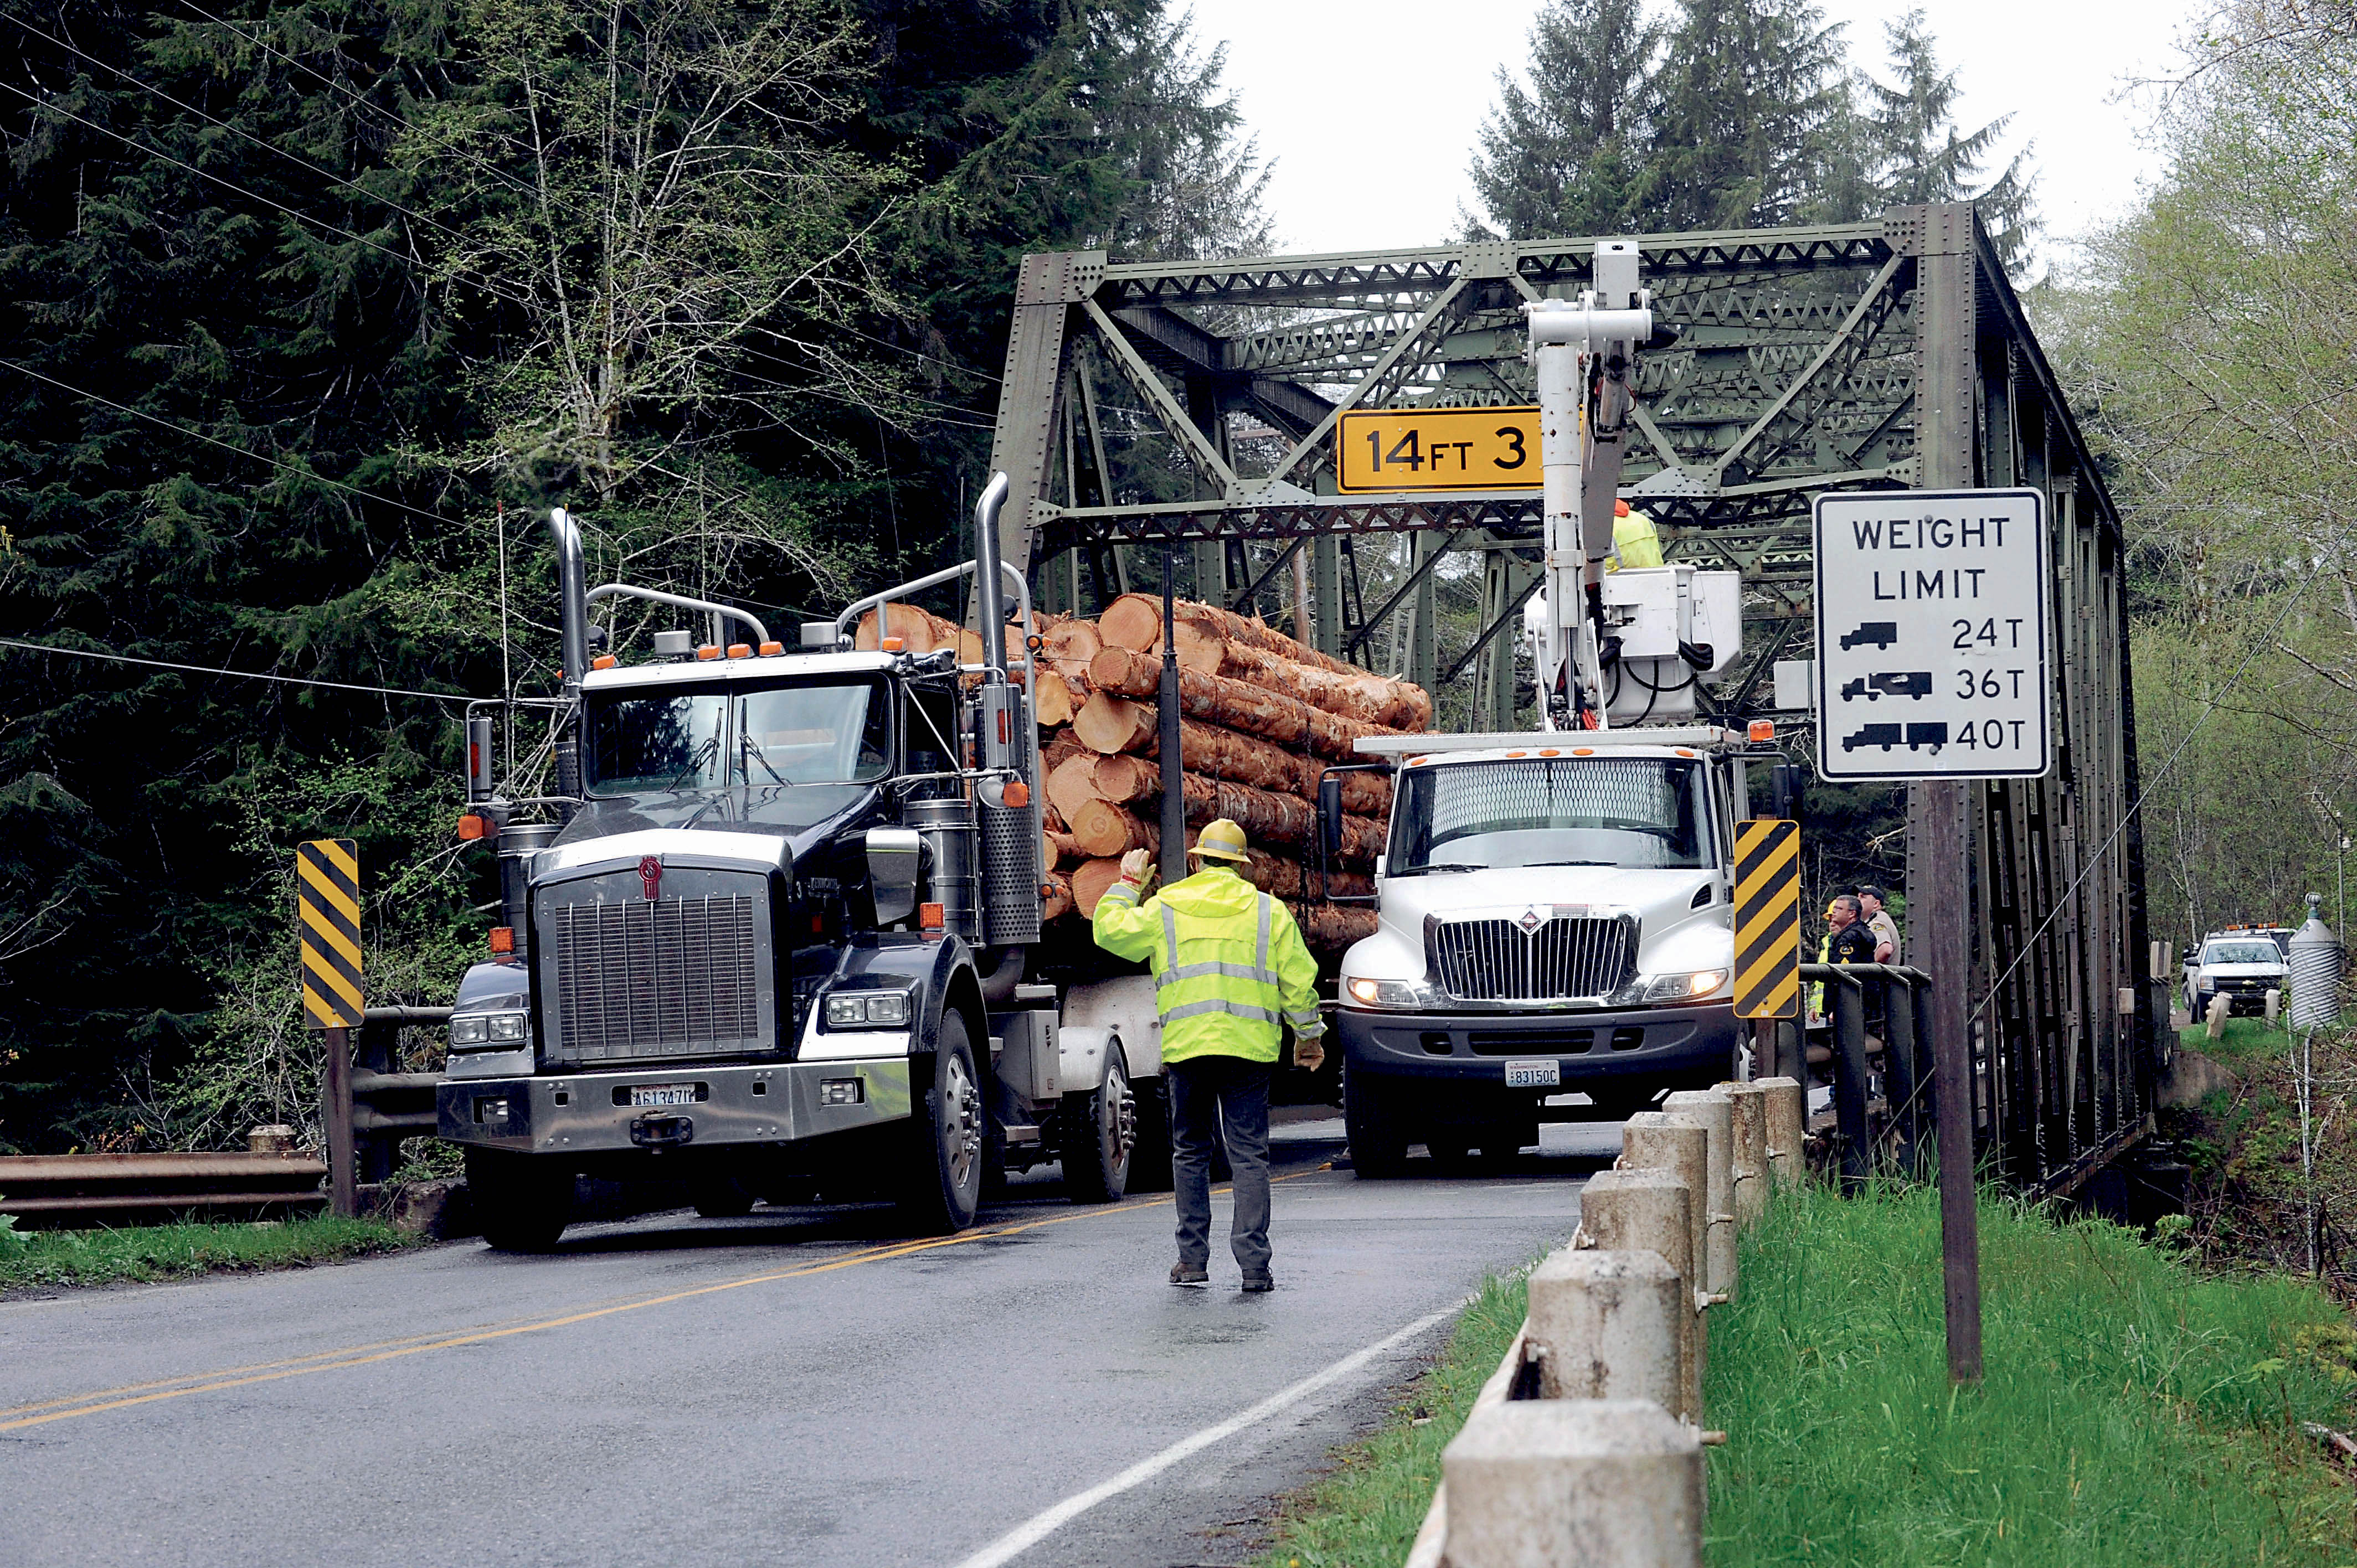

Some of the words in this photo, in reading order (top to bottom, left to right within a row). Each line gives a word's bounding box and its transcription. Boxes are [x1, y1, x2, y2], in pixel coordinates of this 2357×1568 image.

[1493, 426, 1527, 470] 3
[1852, 517, 2010, 550] WEIGHT
[1874, 569, 1986, 601] LIMIT
[1952, 617, 2024, 649] 24T
[1956, 668, 2025, 700] 36T
[1956, 719, 2025, 750] 40T
[1516, 1070, 1557, 1083] 83150C
